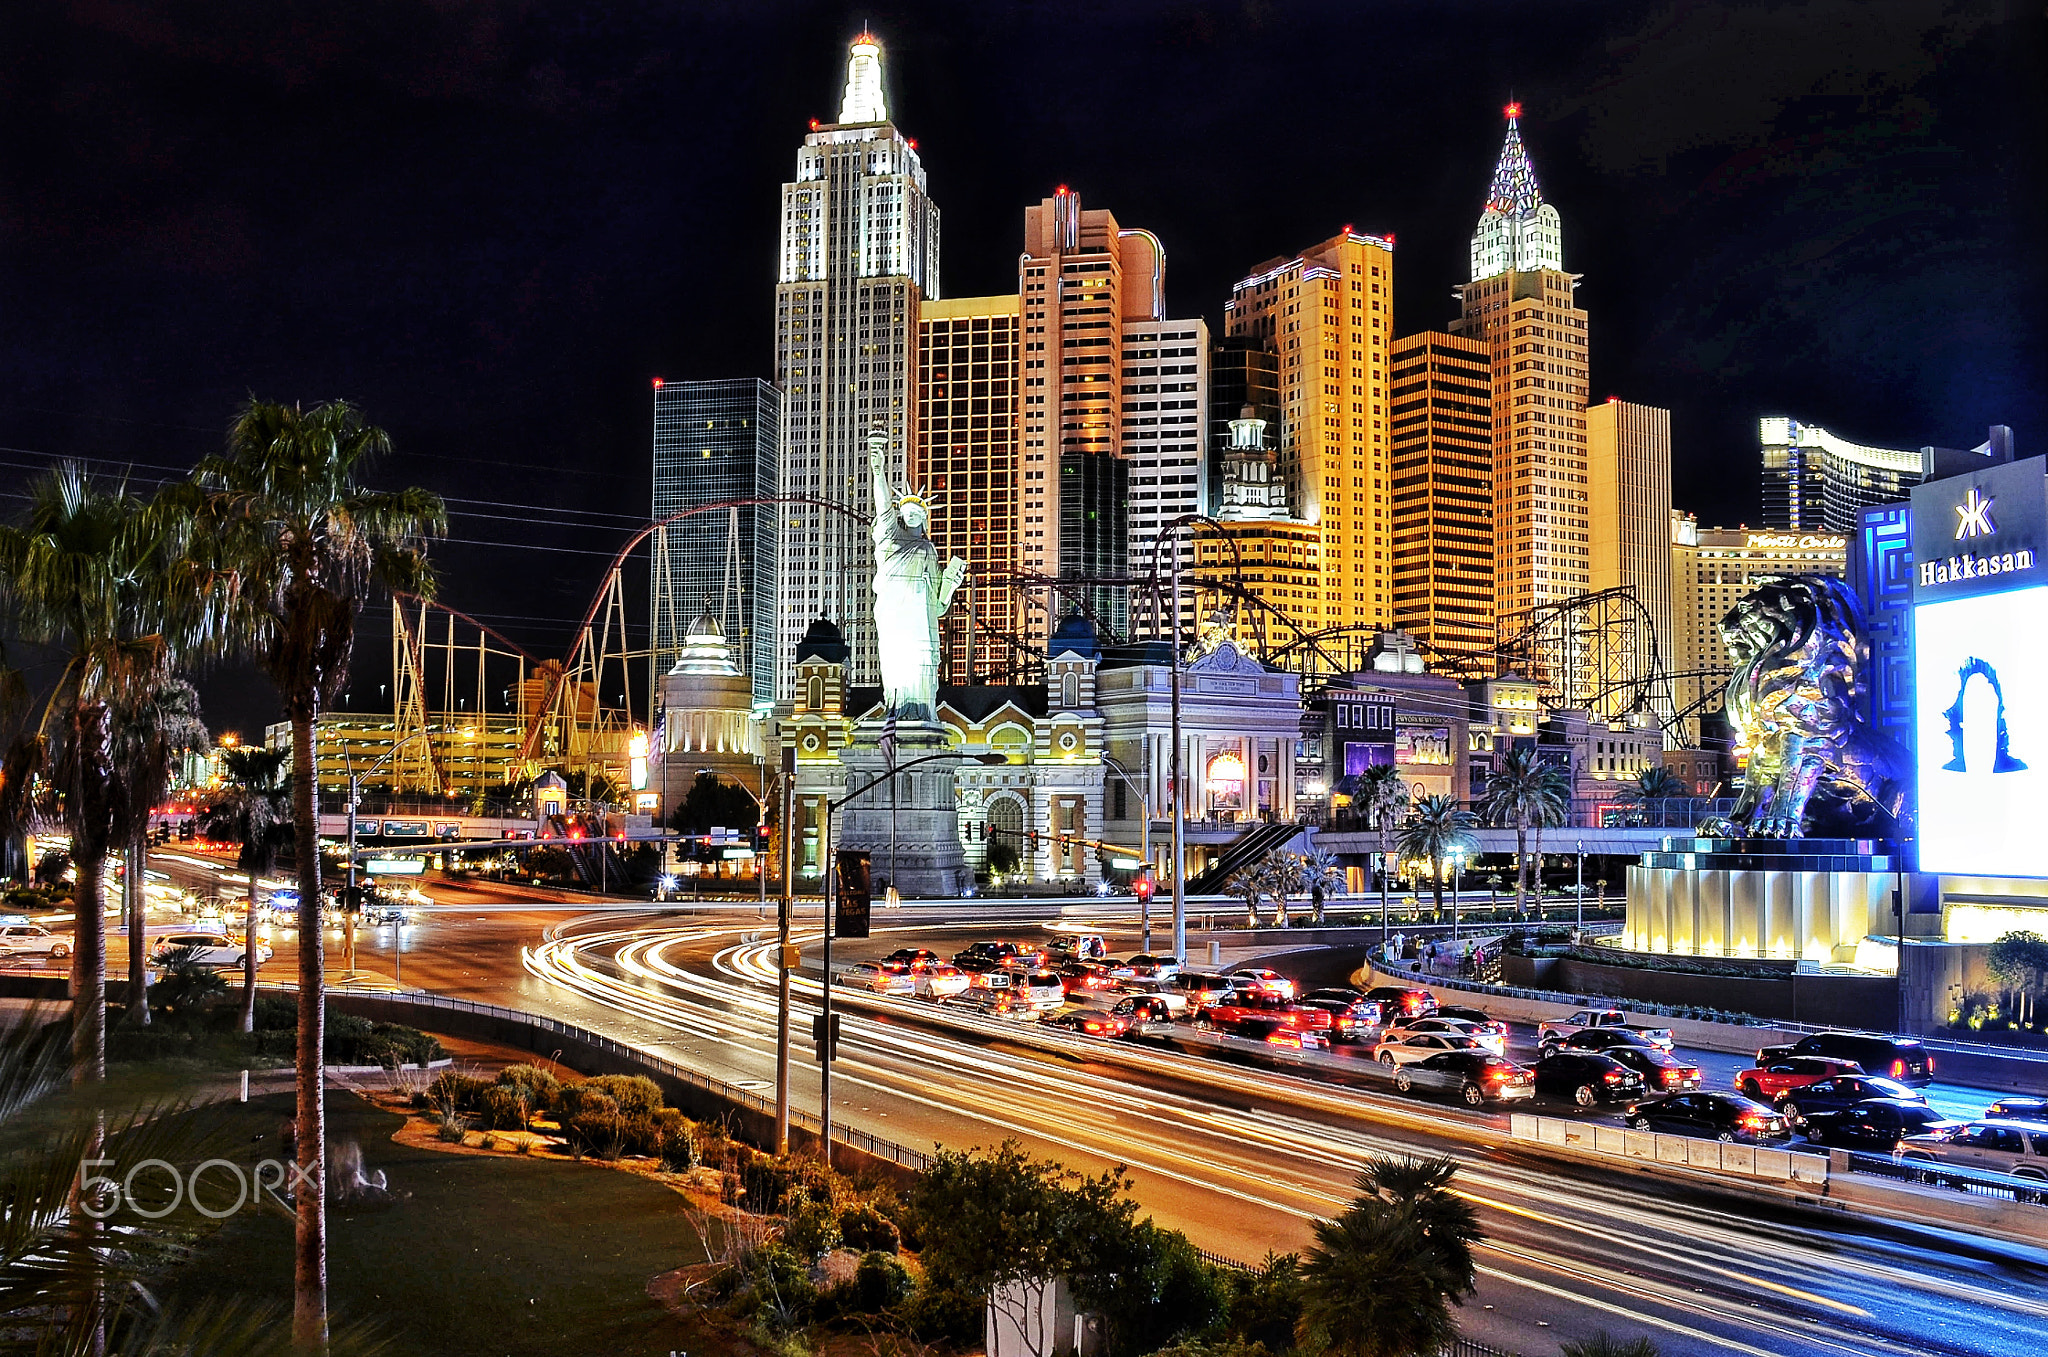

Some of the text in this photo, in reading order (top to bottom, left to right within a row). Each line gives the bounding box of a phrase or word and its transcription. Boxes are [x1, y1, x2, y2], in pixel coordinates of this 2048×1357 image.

[1746, 534, 1846, 549] Monte Carlo
[1919, 549, 2033, 587] Hakkasan
[841, 899, 859, 908] LAS
[840, 908, 867, 916] VEGAS
